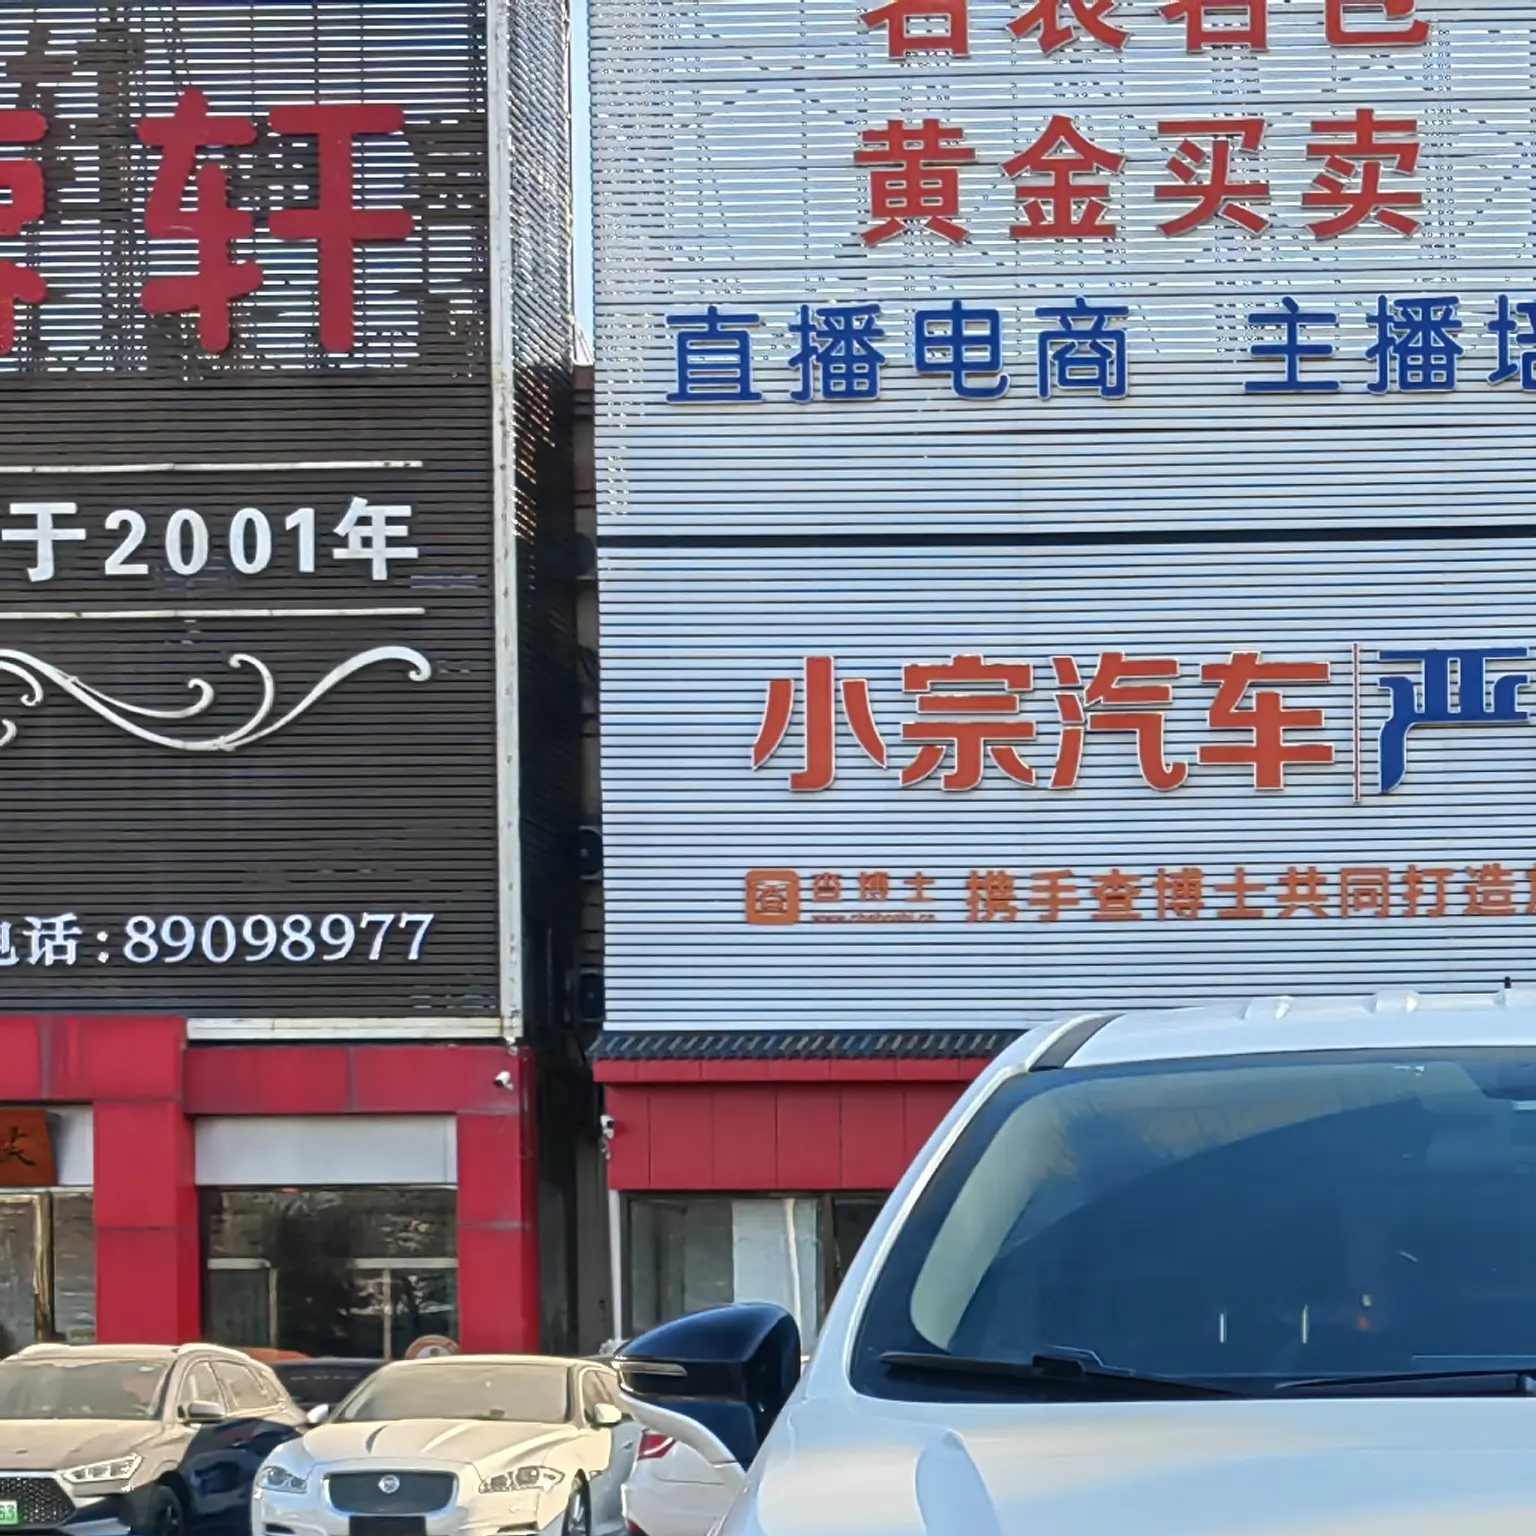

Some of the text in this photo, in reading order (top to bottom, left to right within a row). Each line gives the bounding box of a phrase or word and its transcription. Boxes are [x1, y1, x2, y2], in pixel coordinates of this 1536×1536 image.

[853, 108, 1425, 248] 黄金买卖
[666, 298, 1131, 405] 直播电商
[1, 496, 419, 583] 于2001年
[751, 650, 1334, 793] 小宗汽车
